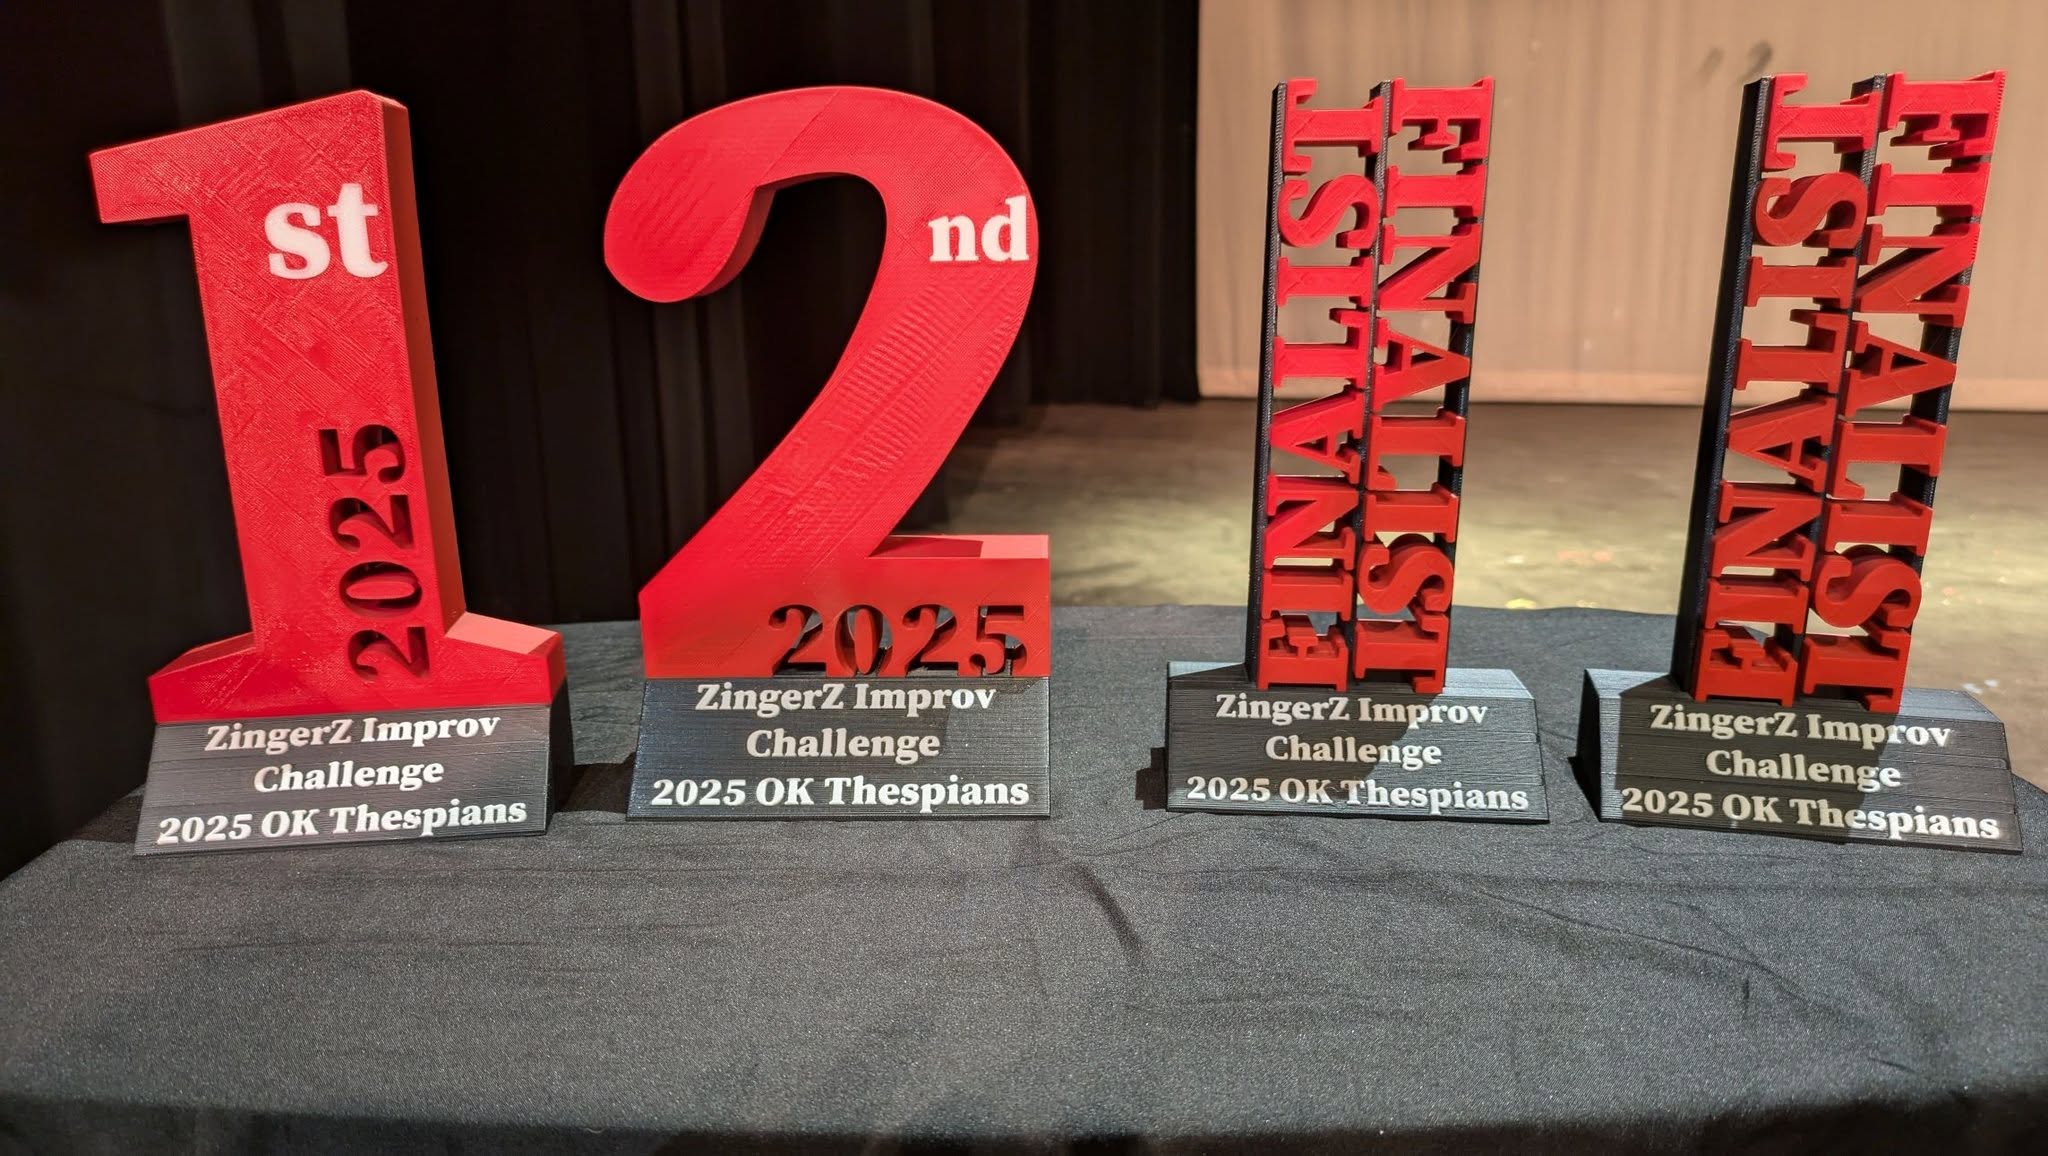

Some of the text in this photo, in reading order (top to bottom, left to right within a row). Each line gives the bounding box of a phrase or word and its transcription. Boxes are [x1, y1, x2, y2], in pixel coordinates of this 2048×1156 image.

[264, 183, 388, 280] st
[928, 195, 1030, 263] nd
[1256, 78, 1387, 693] FINALIST
[1355, 76, 1496, 696] FINALIST
[1693, 73, 1882, 707] FINALIST
[1802, 70, 2007, 713] FINALIST
[318, 423, 431, 679] 2025
[768, 604, 1030, 676] 2025
[695, 681, 997, 718] ZingerZ Improv
[1216, 693, 1489, 729] ZingerZ Improv
[204, 715, 501, 755] ZingerZ Improv
[746, 727, 940, 765] Challenge
[1649, 703, 1952, 751] ZingerZ Improv
[1265, 735, 1443, 771] Challenge
[1705, 749, 1902, 793] Challenge
[254, 760, 445, 795] Challenge
[651, 774, 1030, 814] 2025 OK Thespians
[1186, 776, 1529, 815] 2025 OK Thespians
[157, 799, 528, 844] 2025 OK Thespians
[1621, 787, 2001, 841] 2025 OK Thespians
